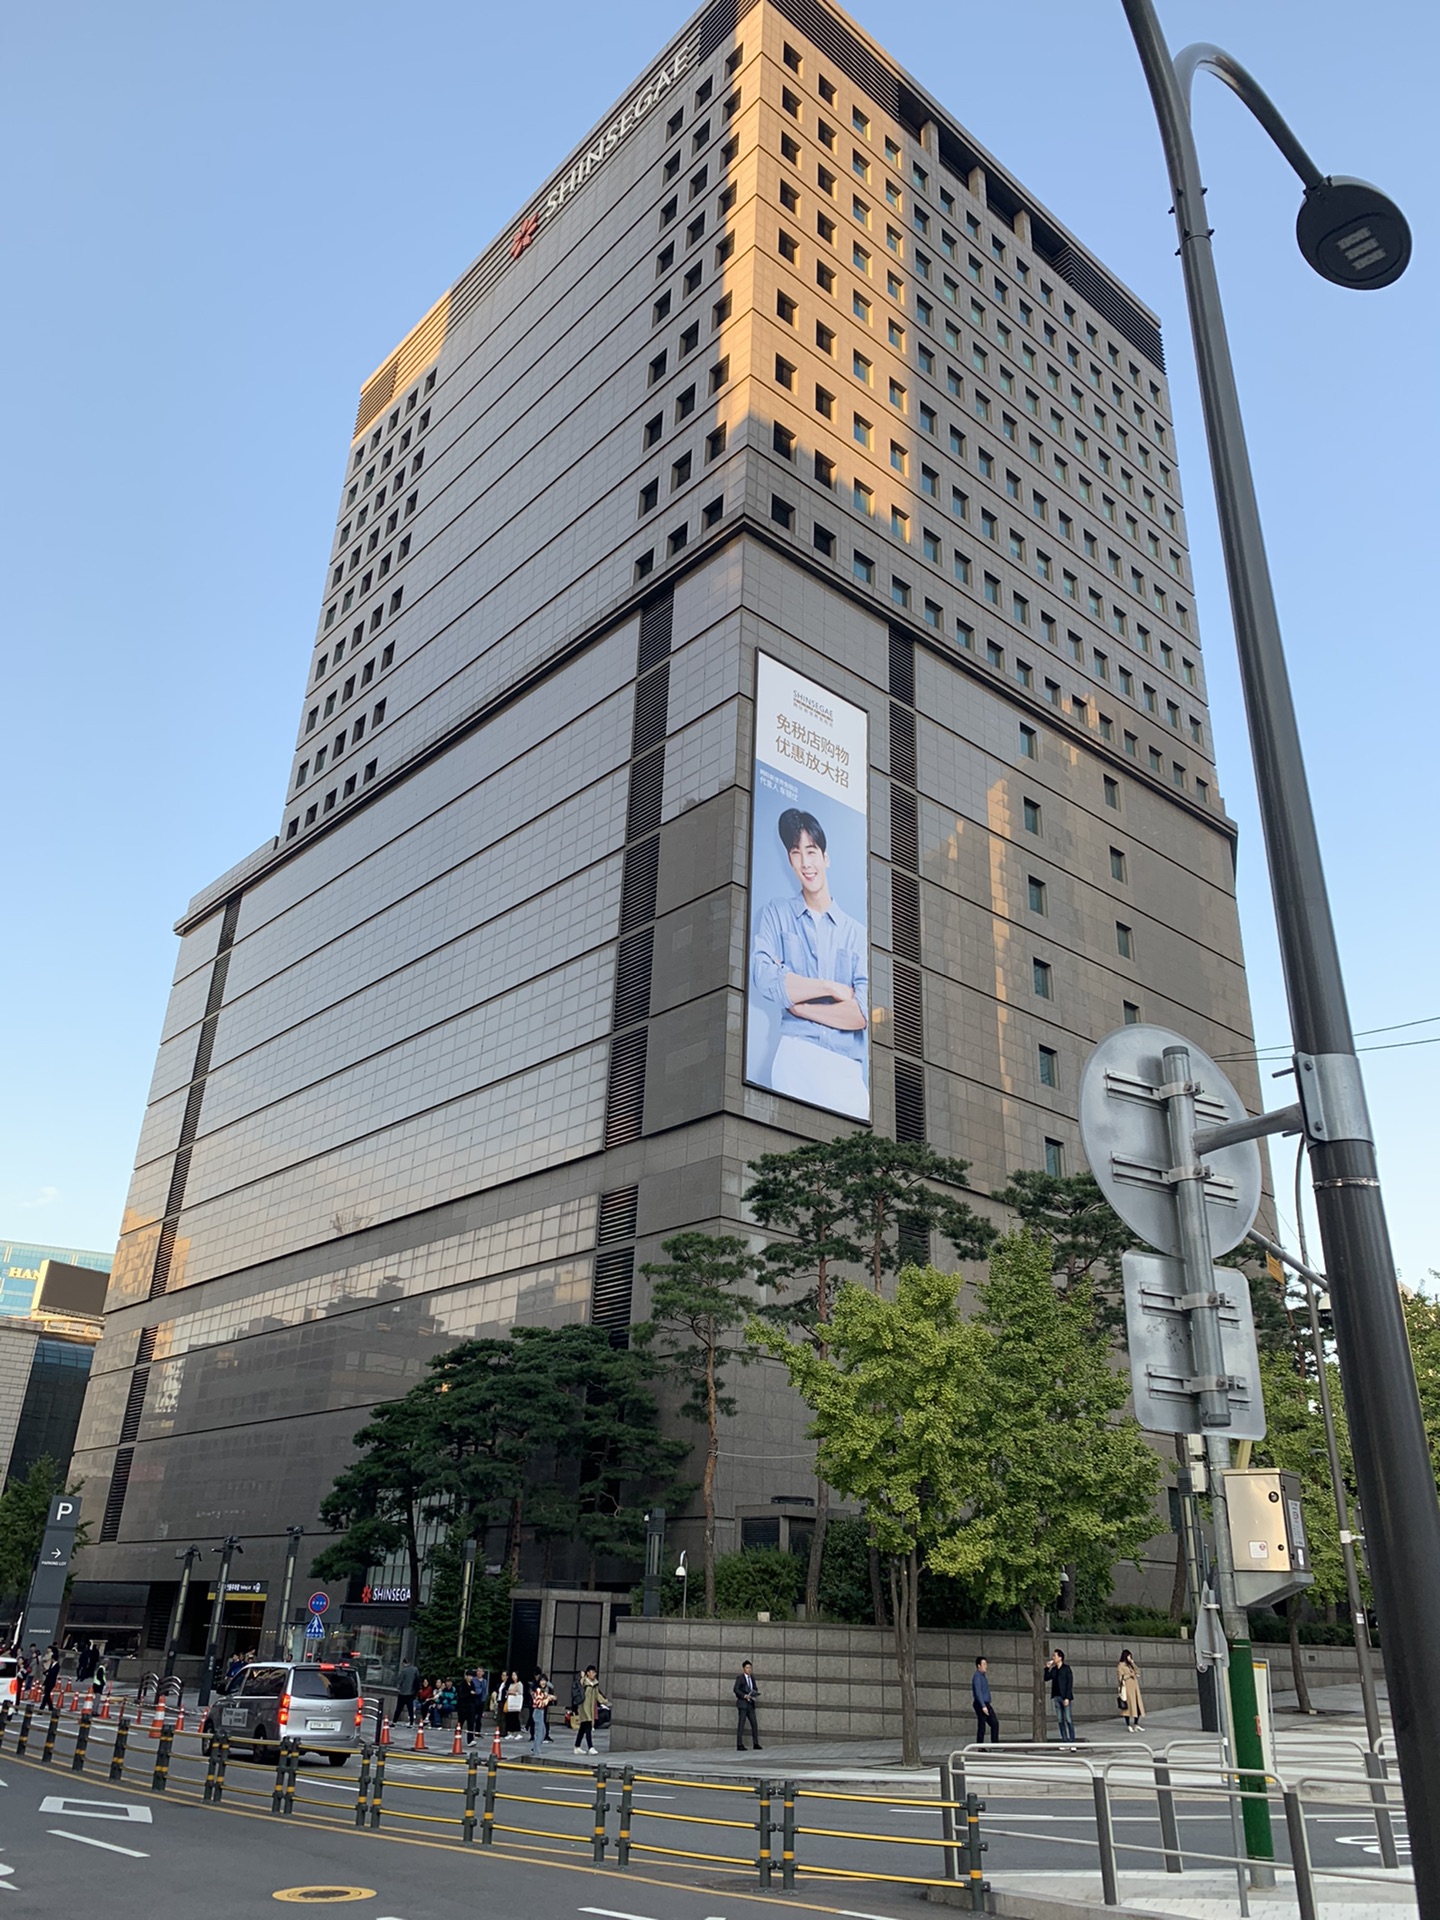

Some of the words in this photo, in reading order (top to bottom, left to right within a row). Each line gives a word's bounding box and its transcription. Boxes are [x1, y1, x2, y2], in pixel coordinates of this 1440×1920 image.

[545, 46, 691, 219] SHINSEGAE
[793, 689, 833, 717] SHINSEGAE
[775, 735, 849, 788] 优惠放大招
[776, 713, 849, 766] 免税店购物
[56, 1502, 73, 1521] P
